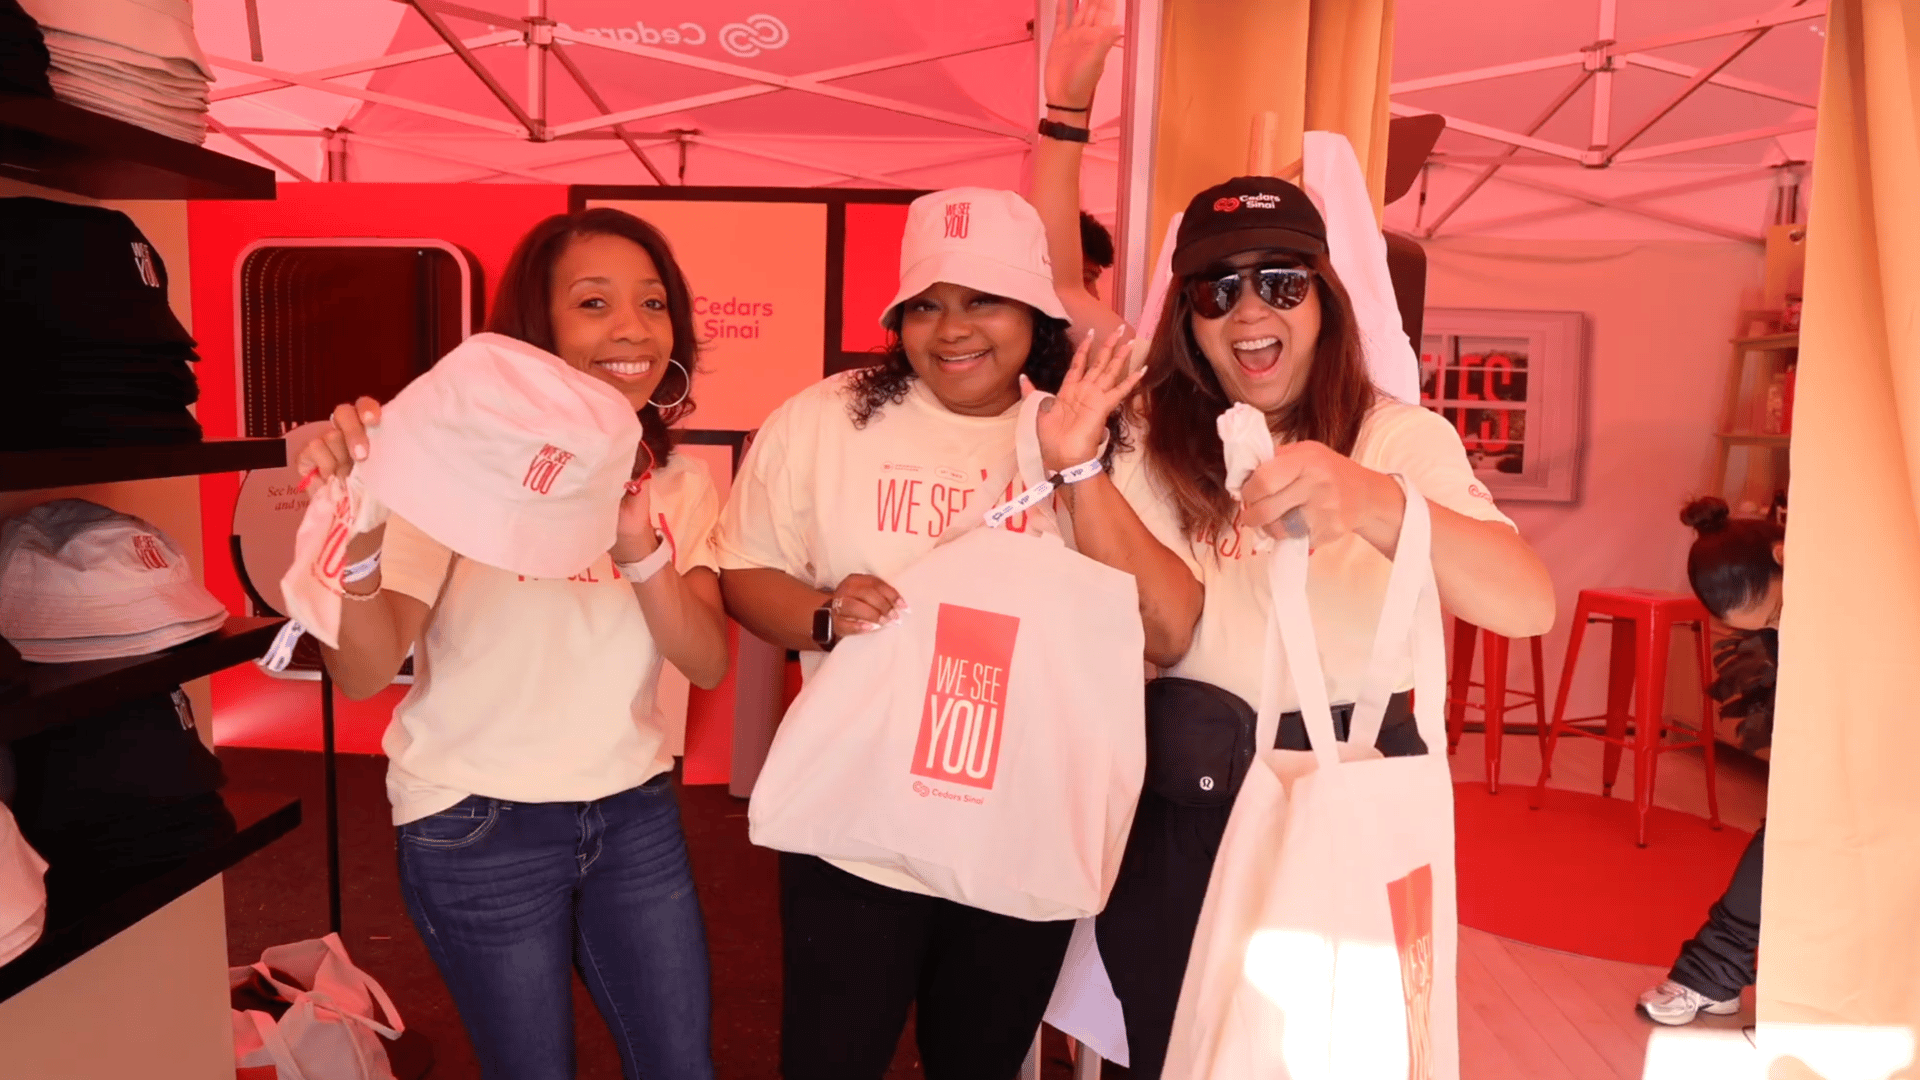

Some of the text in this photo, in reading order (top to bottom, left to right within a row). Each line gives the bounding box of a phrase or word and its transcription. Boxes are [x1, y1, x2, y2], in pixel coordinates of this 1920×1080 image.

[1239, 192, 1281, 203] Cedars
[1245, 200, 1276, 209] Sinai
[944, 214, 970, 239] YOU
[694, 295, 774, 317] Cedars
[704, 319, 760, 339] Sinai
[522, 455, 565, 495] YOU
[274, 499, 296, 511] and
[877, 478, 923, 536] WE
[134, 547, 169, 570] YOU
[936, 654, 1003, 706] WE SEE
[925, 693, 998, 780] YOU
[931, 788, 985, 806] Cedars Sinai
